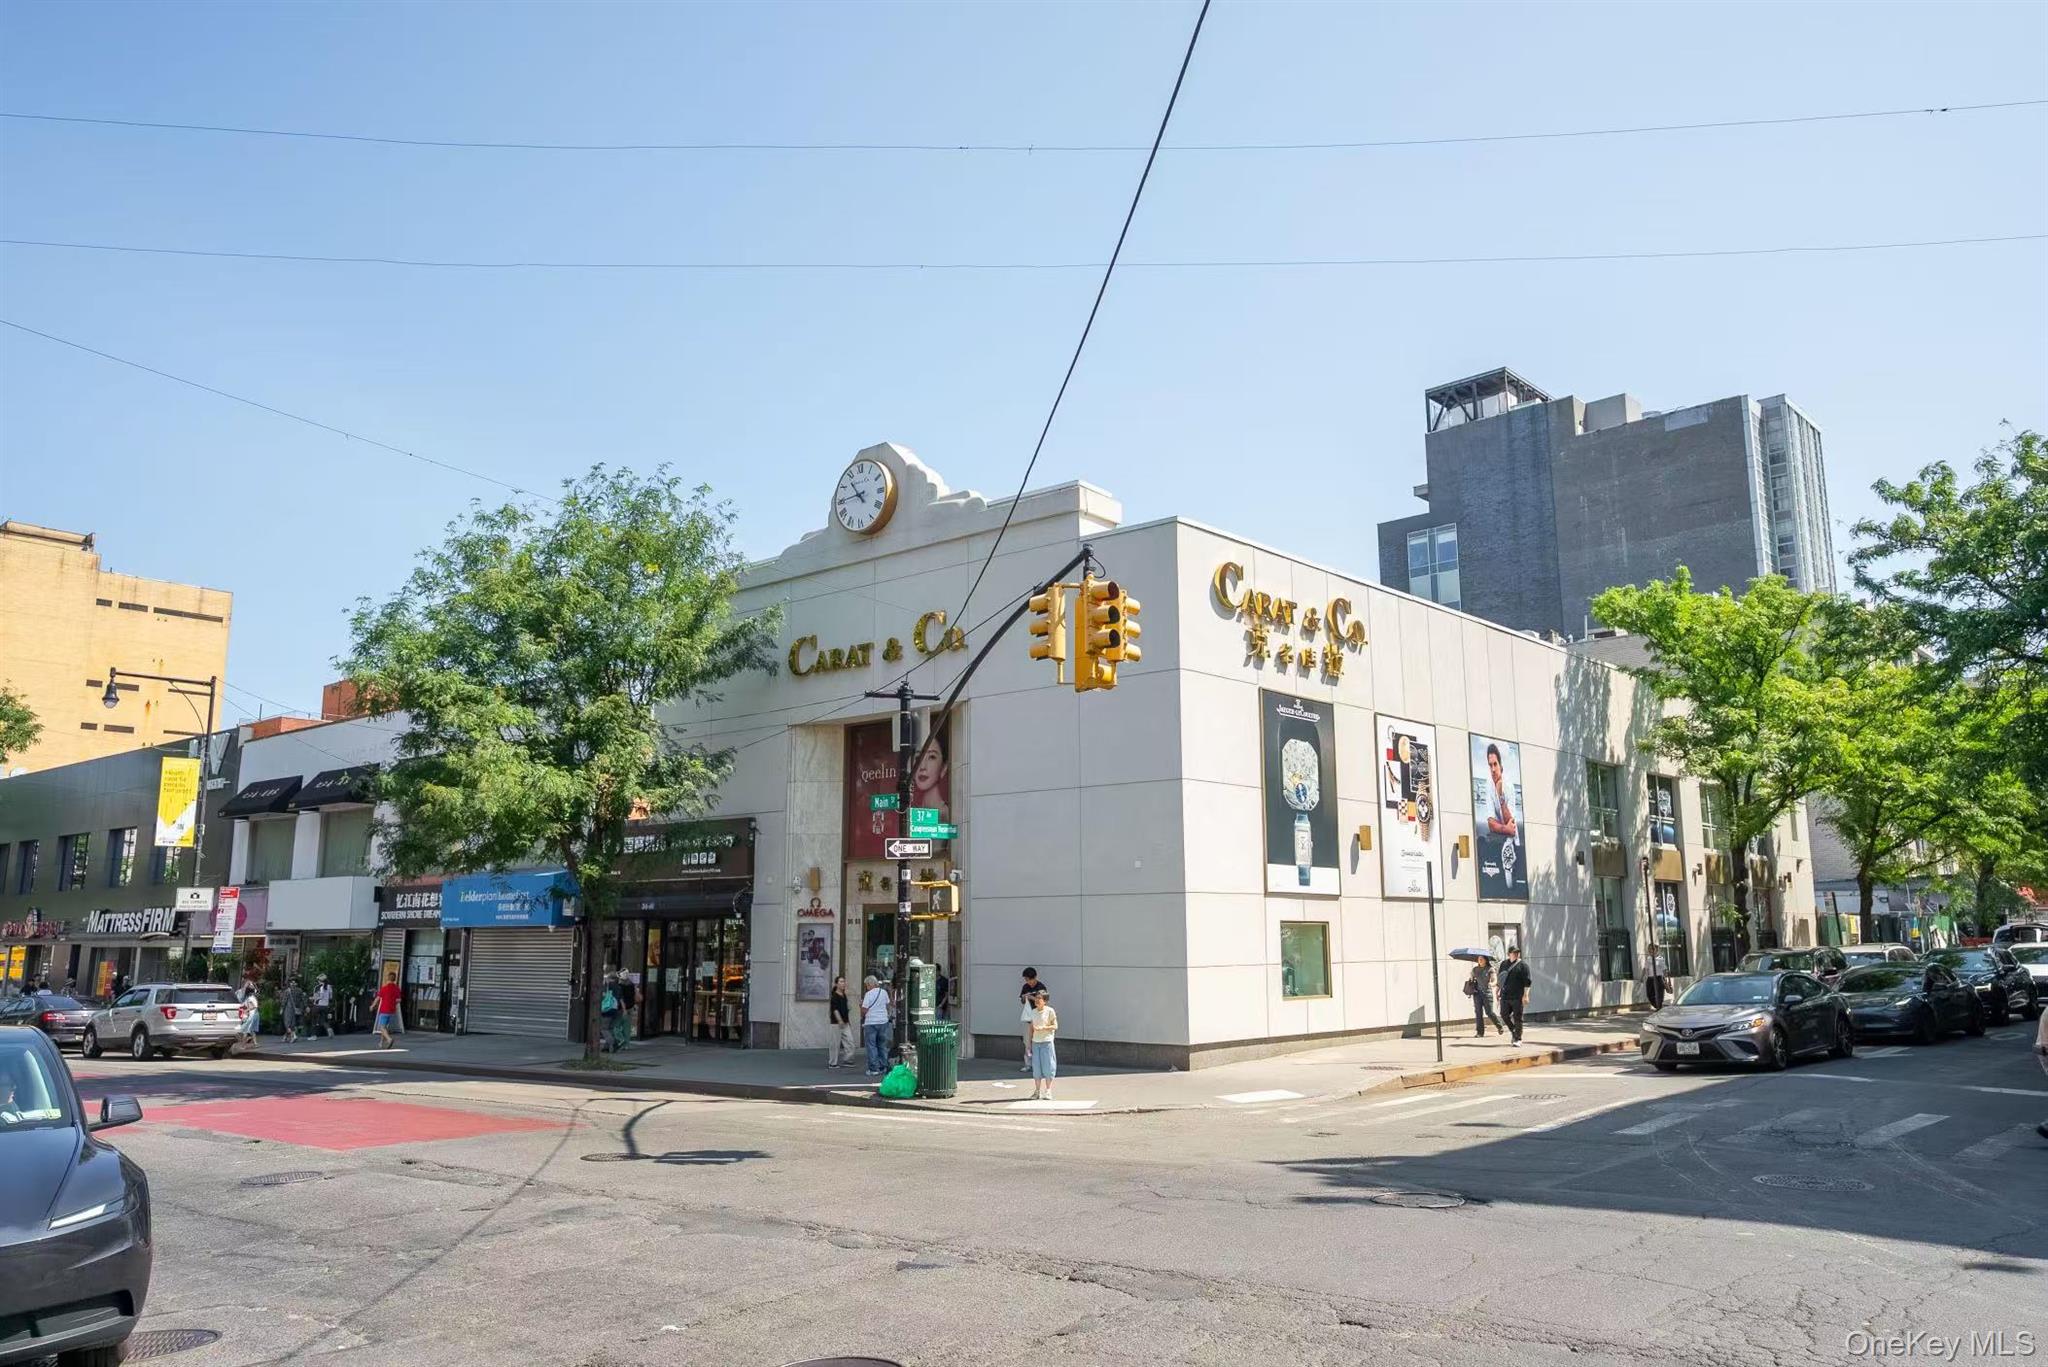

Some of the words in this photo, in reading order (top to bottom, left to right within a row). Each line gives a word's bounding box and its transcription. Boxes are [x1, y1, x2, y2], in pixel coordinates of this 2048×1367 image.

[1303, 607, 1321, 632] &
[882, 638, 903, 663] &
[874, 796, 889, 808] Main
[916, 810, 925, 822] 37
[893, 844, 907, 853] ONE
[912, 844, 925, 852] WAY
[797, 907, 835, 919] OMEGA
